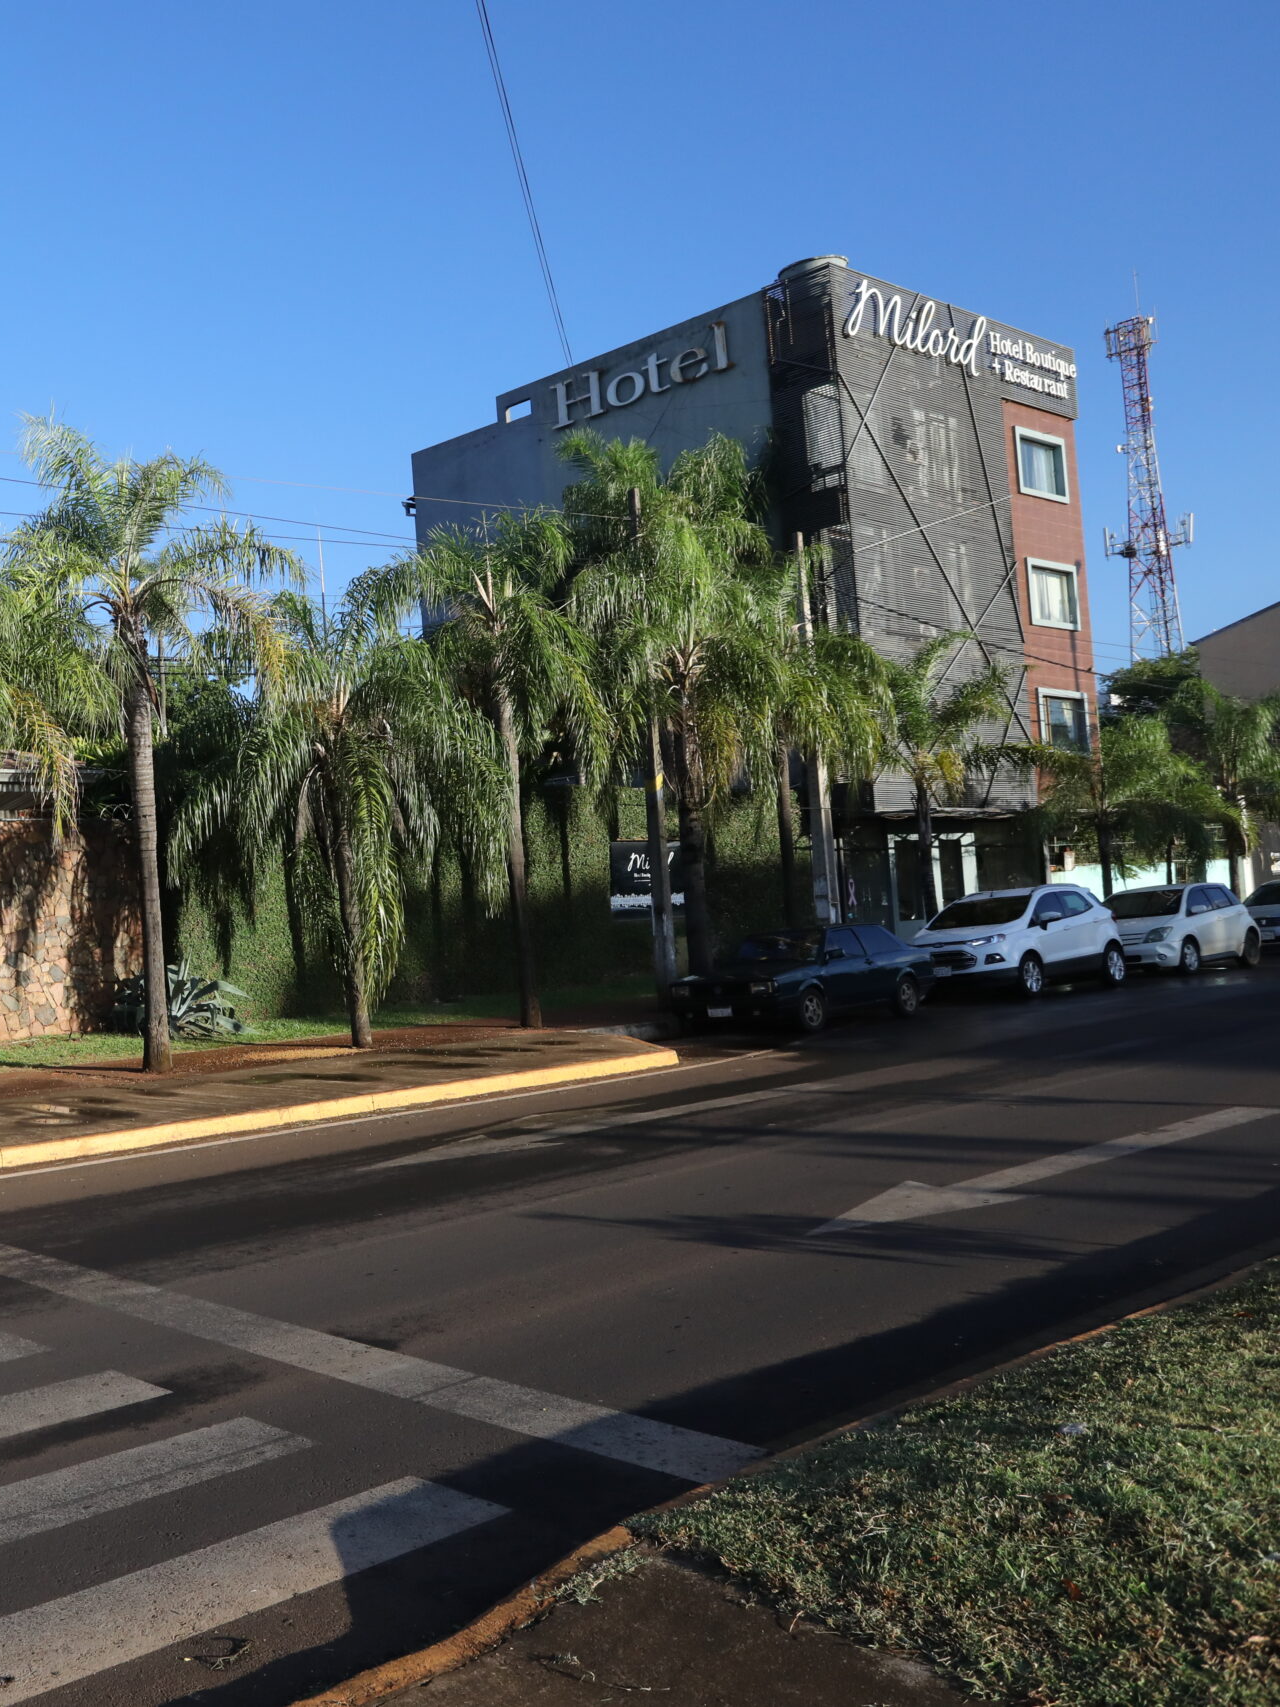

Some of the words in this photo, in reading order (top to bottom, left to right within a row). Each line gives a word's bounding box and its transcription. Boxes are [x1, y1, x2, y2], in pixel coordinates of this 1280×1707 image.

[847, 279, 987, 376] Milord
[989, 331, 1023, 359] Hotel
[1025, 341, 1077, 380] Boutique
[550, 320, 736, 430] Hotel
[1004, 360, 1069, 399] Restaurant
